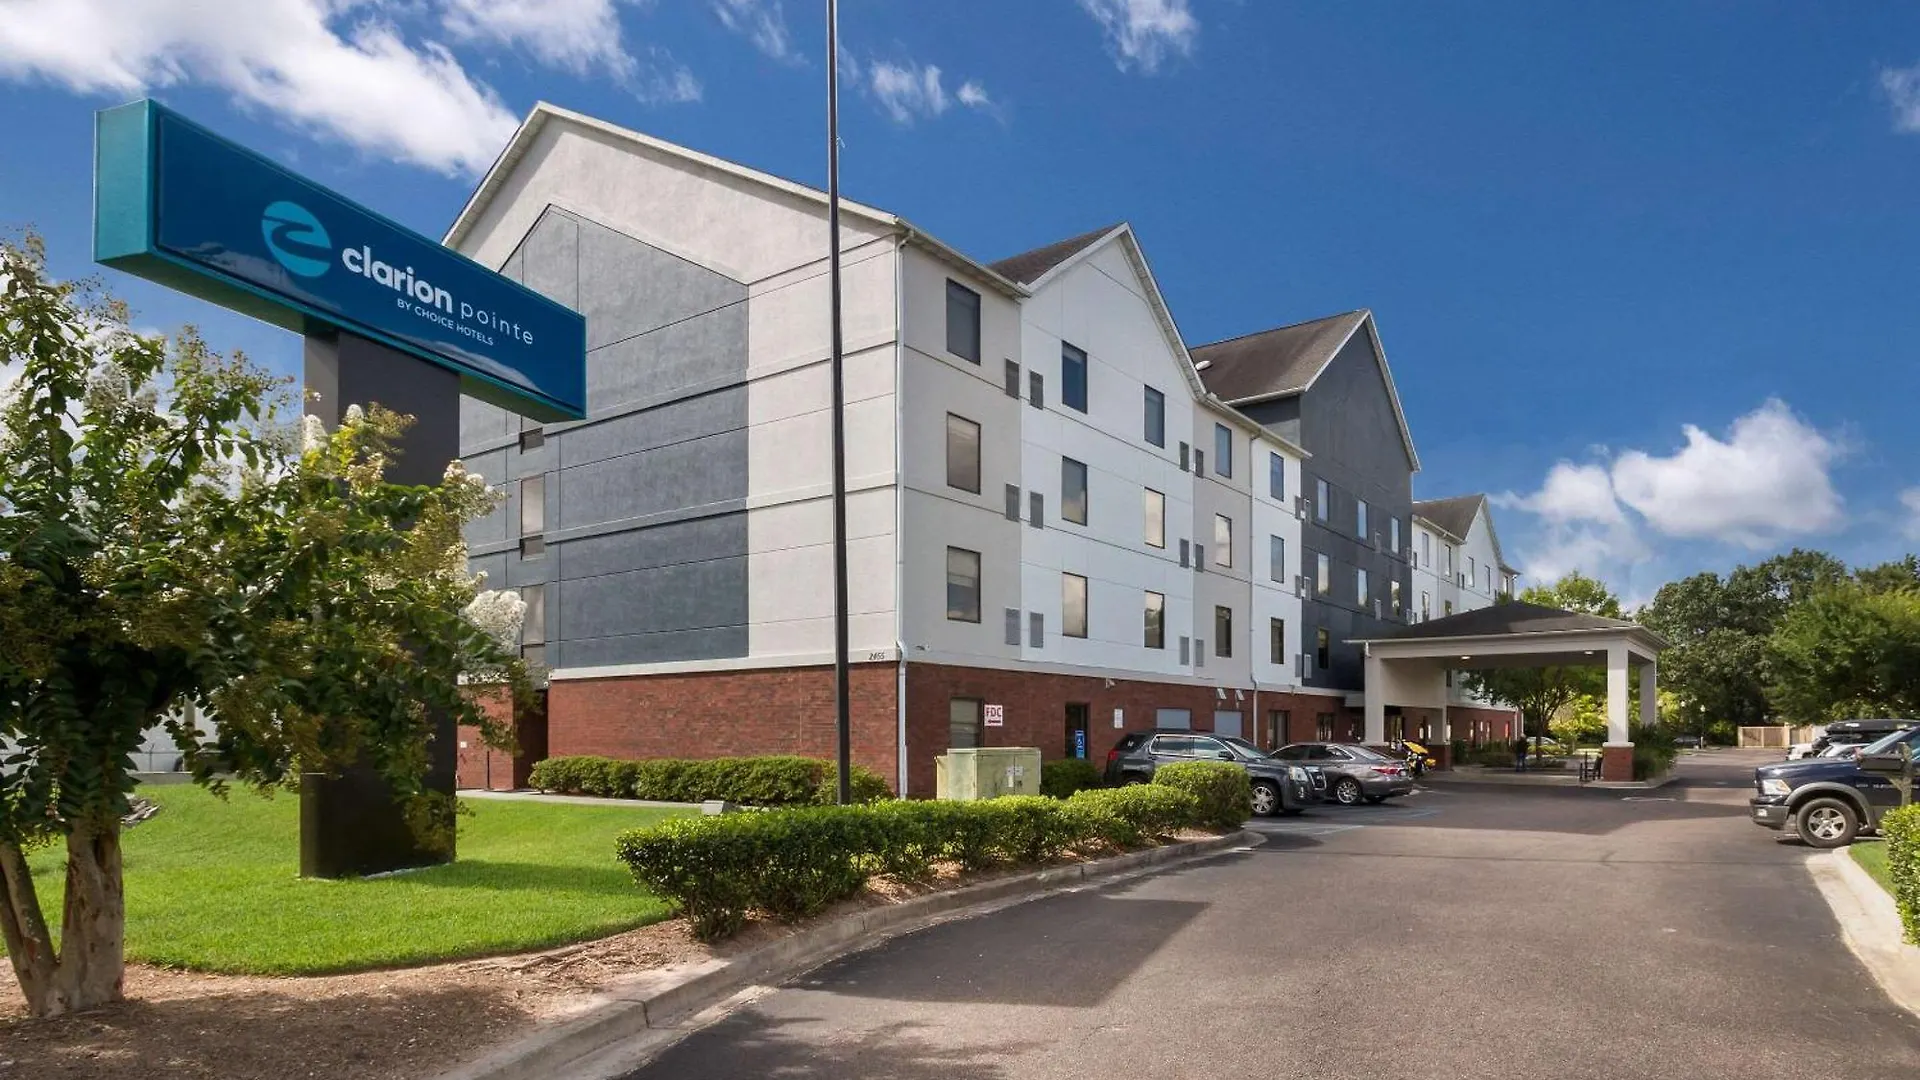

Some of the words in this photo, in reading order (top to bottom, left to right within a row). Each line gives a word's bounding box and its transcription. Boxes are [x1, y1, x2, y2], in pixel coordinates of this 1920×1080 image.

[342, 245, 453, 313] clarion
[461, 302, 534, 344] pointe
[397, 299, 412, 311] BY
[414, 306, 454, 330] CHOICE
[456, 323, 494, 346] HOTELS
[985, 707, 1002, 718] FDC
